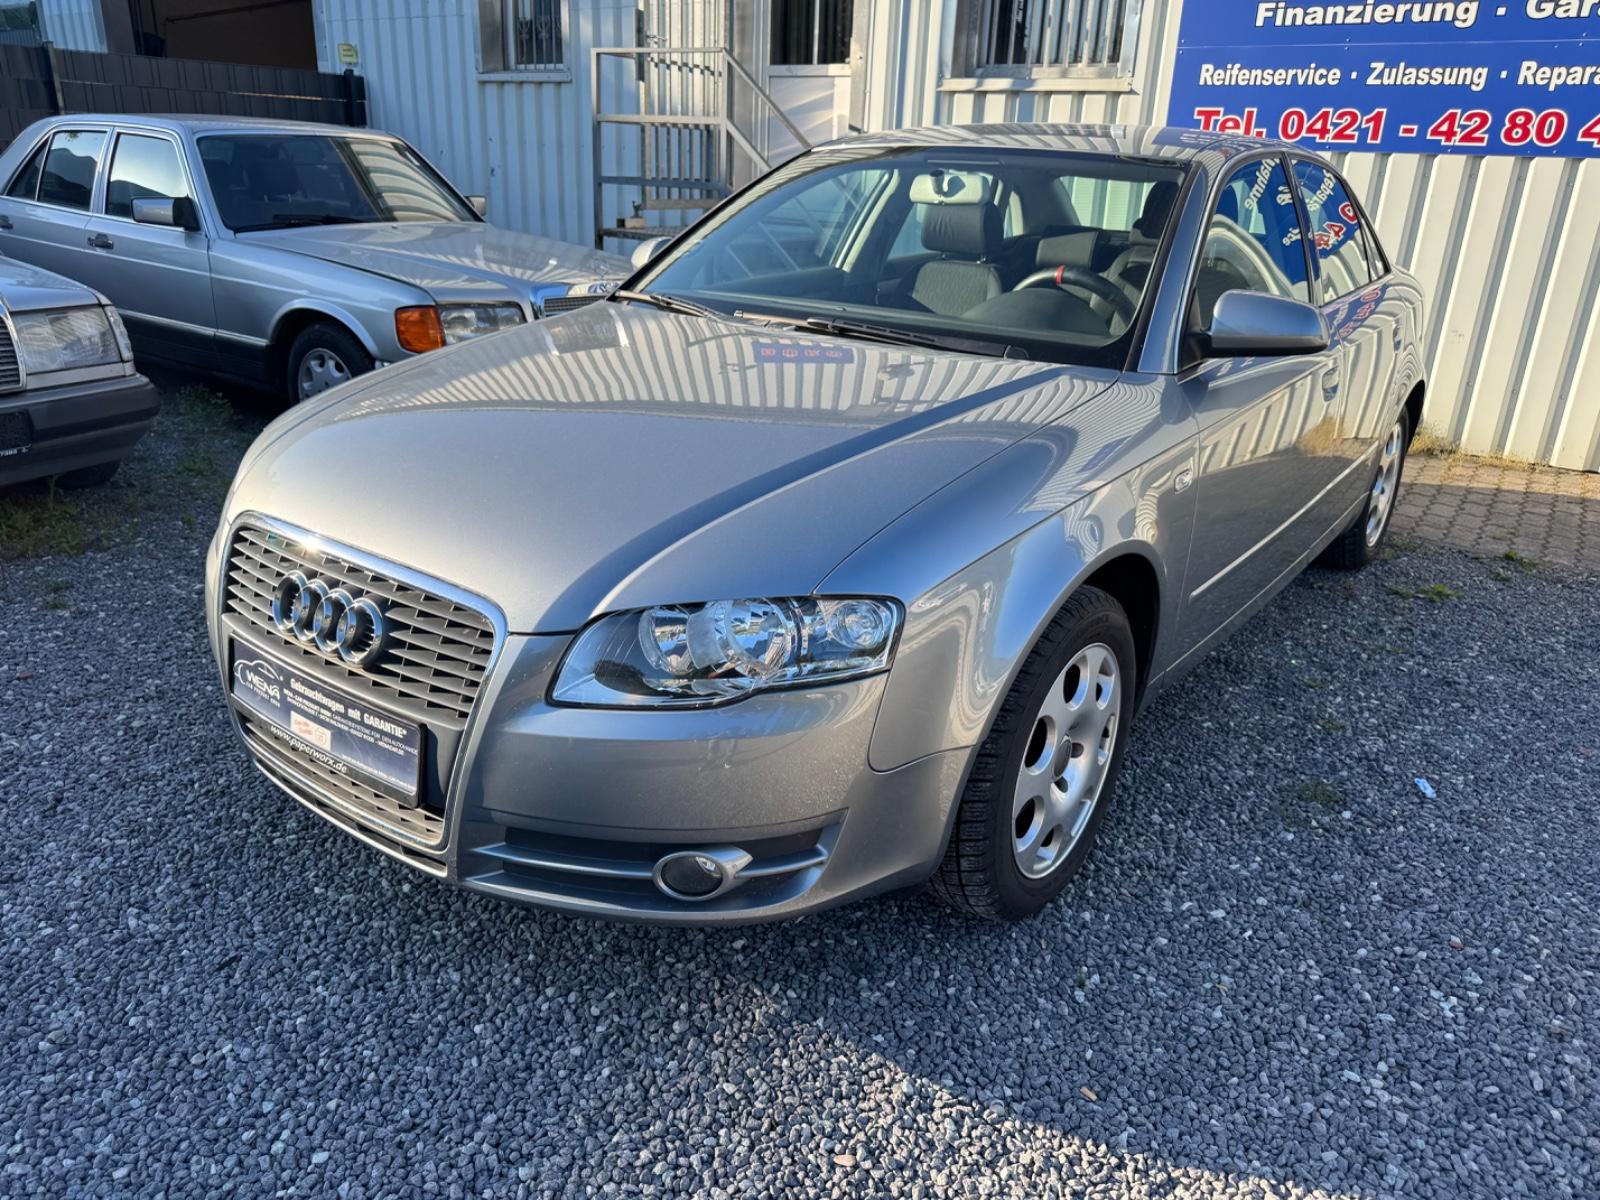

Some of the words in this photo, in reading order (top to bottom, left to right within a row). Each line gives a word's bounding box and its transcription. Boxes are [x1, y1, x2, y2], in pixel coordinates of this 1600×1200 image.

[1255, 0, 1480, 28] Finanzierung
[1526, 0, 1600, 19] Gar
[1198, 63, 1341, 87] Reifenservice
[1365, 61, 1488, 92] Zulassung
[1194, 107, 1267, 139] Tel.
[1279, 108, 1387, 144] 0421
[1428, 109, 1492, 147] 42
[1500, 108, 1568, 147] 80
[245, 669, 280, 700] WENA
[347, 707, 361, 721] mit
[270, 725, 347, 773] www.paperworx.de
